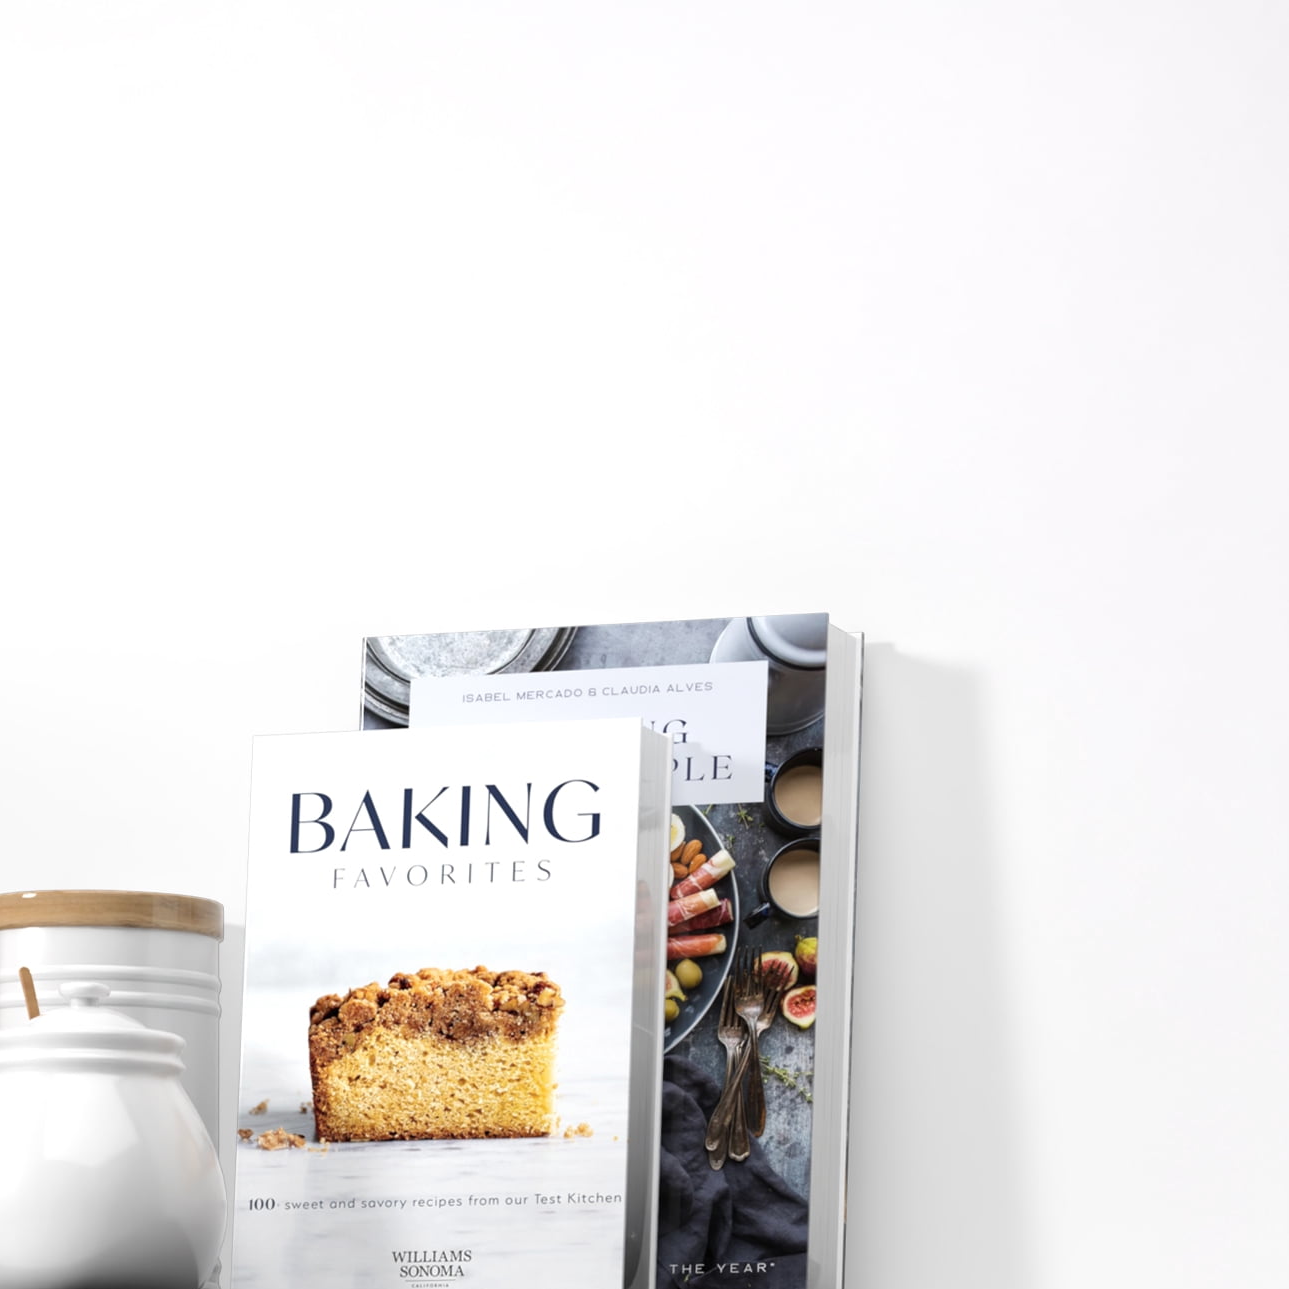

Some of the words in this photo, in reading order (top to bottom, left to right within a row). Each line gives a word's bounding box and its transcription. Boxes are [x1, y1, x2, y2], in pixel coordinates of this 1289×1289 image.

[462, 692, 511, 703] ISABEL
[516, 688, 583, 700] MERCADO
[602, 684, 660, 696] CLAUDIA
[666, 682, 714, 693] ALVES
[289, 779, 601, 854] BAKING
[333, 859, 552, 889] FAVORITES
[285, 1200, 324, 1210] sweet
[329, 1198, 356, 1209] and
[361, 1198, 407, 1210] savory
[412, 1196, 463, 1208] recipes
[468, 1195, 500, 1206] from
[505, 1196, 529, 1206] our
[534, 1193, 562, 1205] Test
[567, 1192, 622, 1204] Kitchen
[392, 1250, 472, 1264] WILLIAMS
[399, 1264, 465, 1278] SONOMA
[669, 1263, 705, 1274] THE
